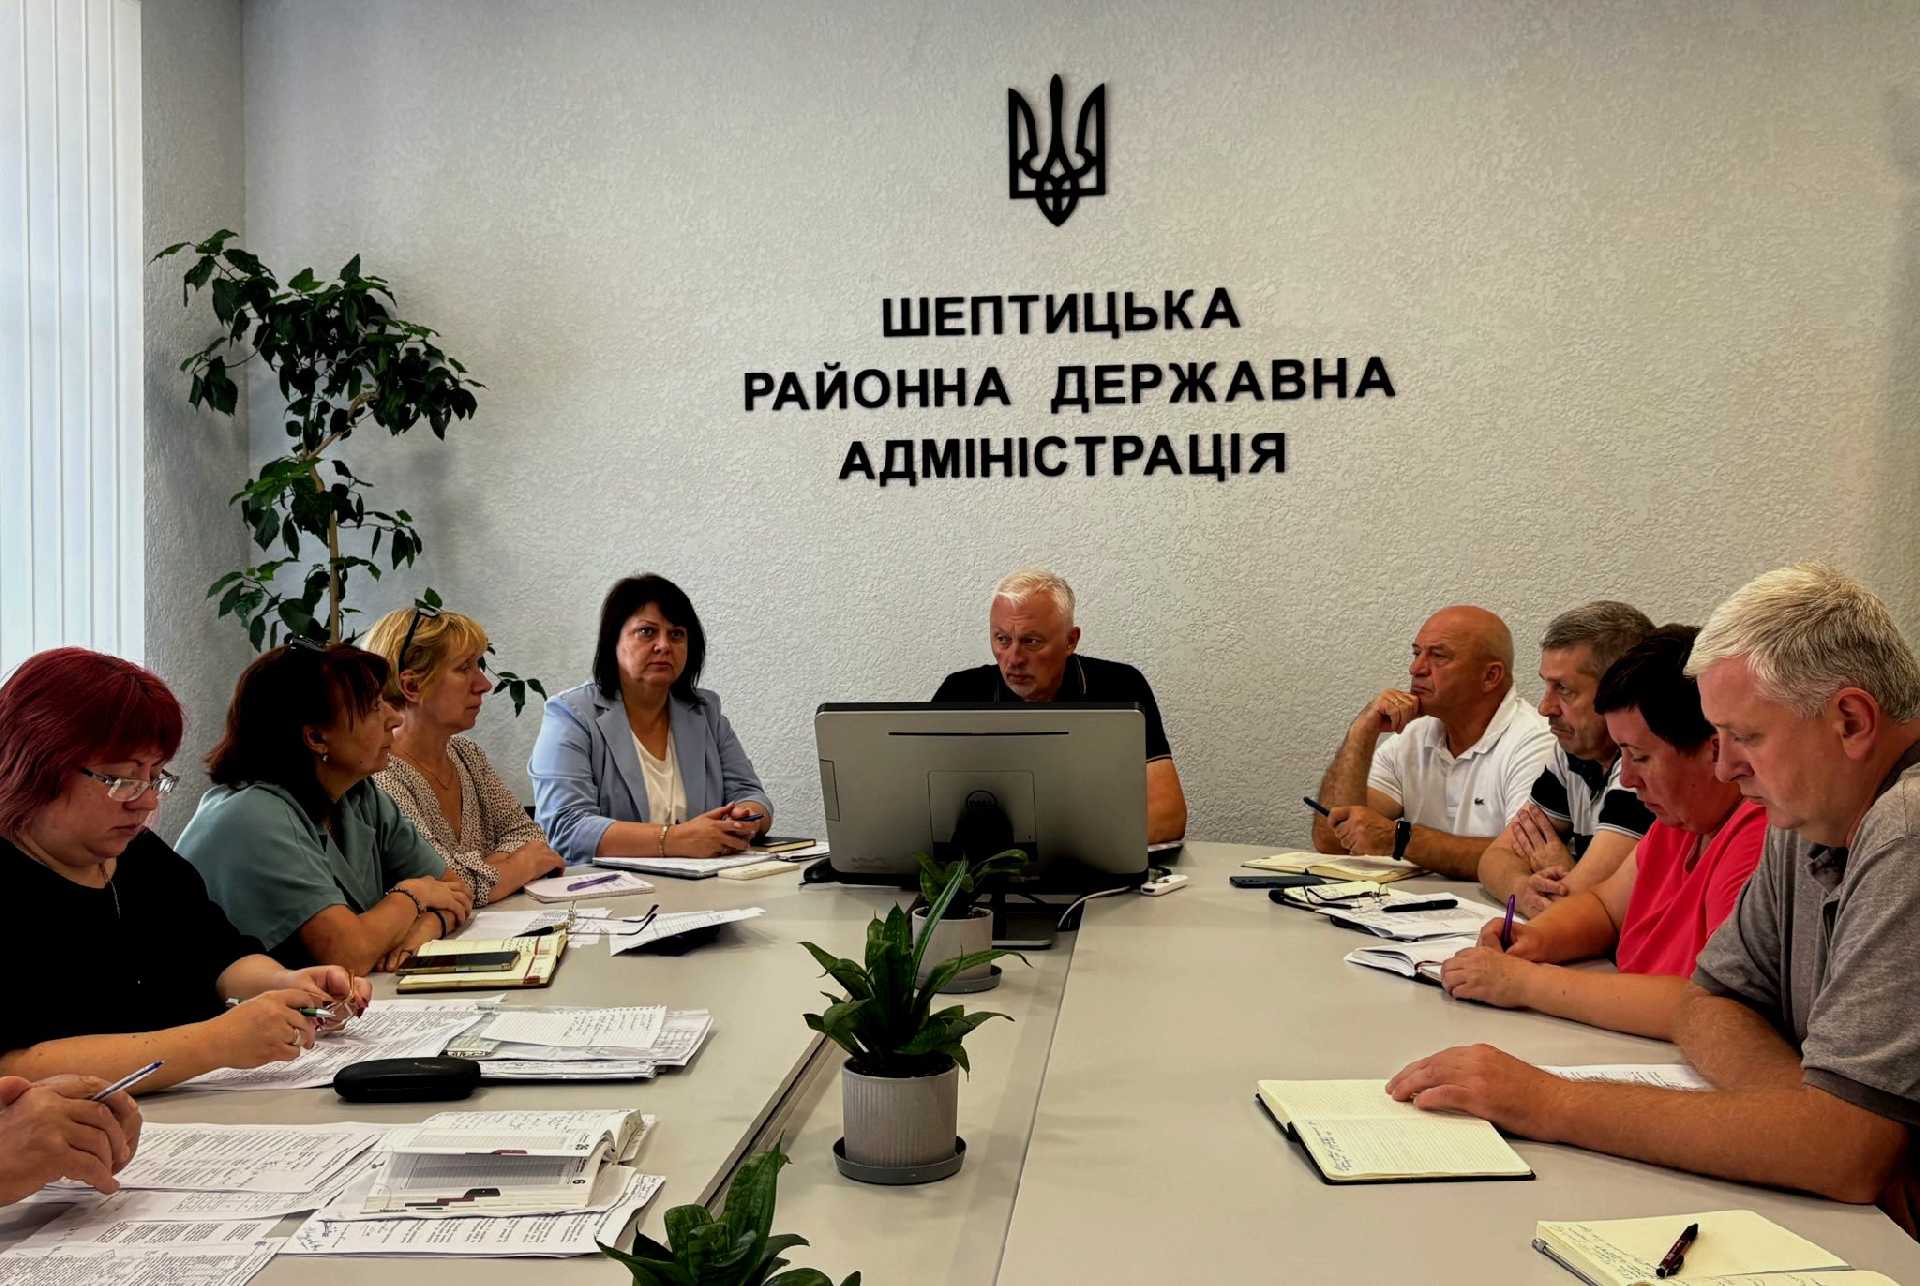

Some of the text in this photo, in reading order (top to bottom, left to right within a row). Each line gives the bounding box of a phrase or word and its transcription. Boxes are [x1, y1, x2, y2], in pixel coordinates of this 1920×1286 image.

[882, 288, 1241, 340] ШЕПТИЦЬКА
[744, 357, 1396, 415] РАЙОННА ДЕРЖАВНА
[838, 432, 1286, 488] АДМІНІСТРАЦІЯ
